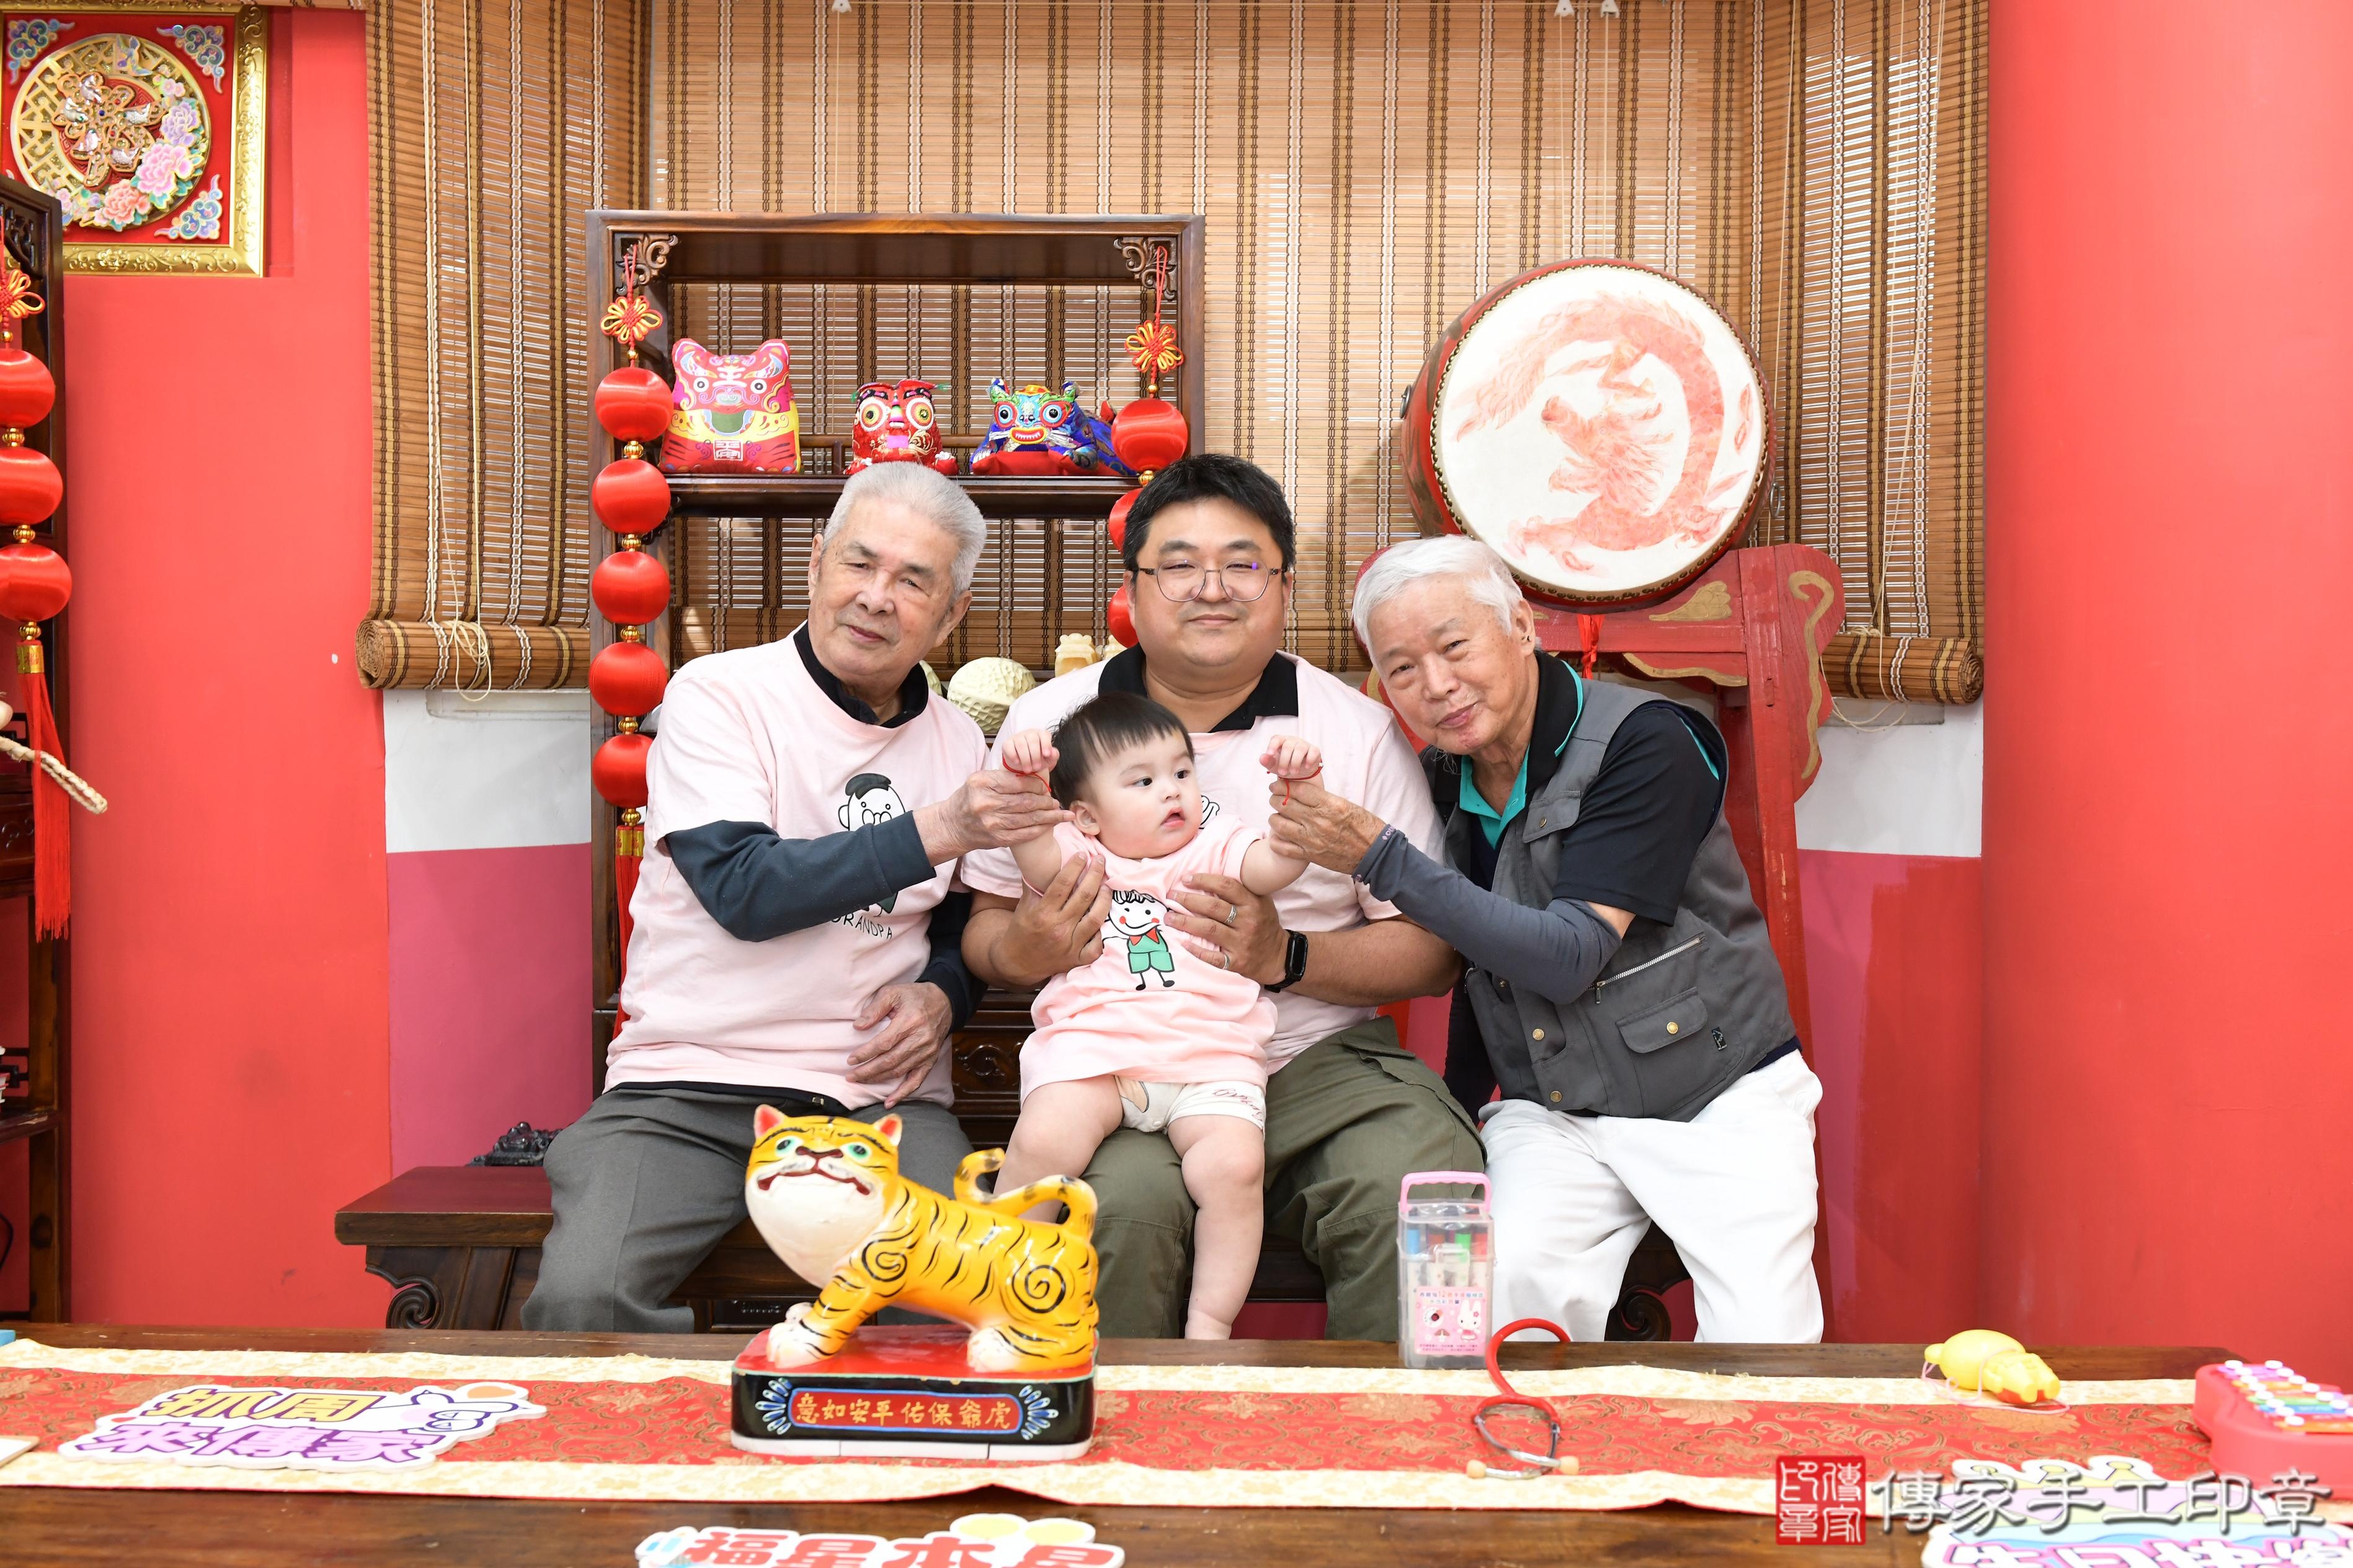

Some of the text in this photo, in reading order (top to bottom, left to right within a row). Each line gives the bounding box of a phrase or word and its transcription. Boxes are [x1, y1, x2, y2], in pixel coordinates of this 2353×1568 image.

[832, 913, 892, 940] RANDPA
[140, 1388, 386, 1422] 抓周
[75, 1422, 447, 1463] 來傳家
